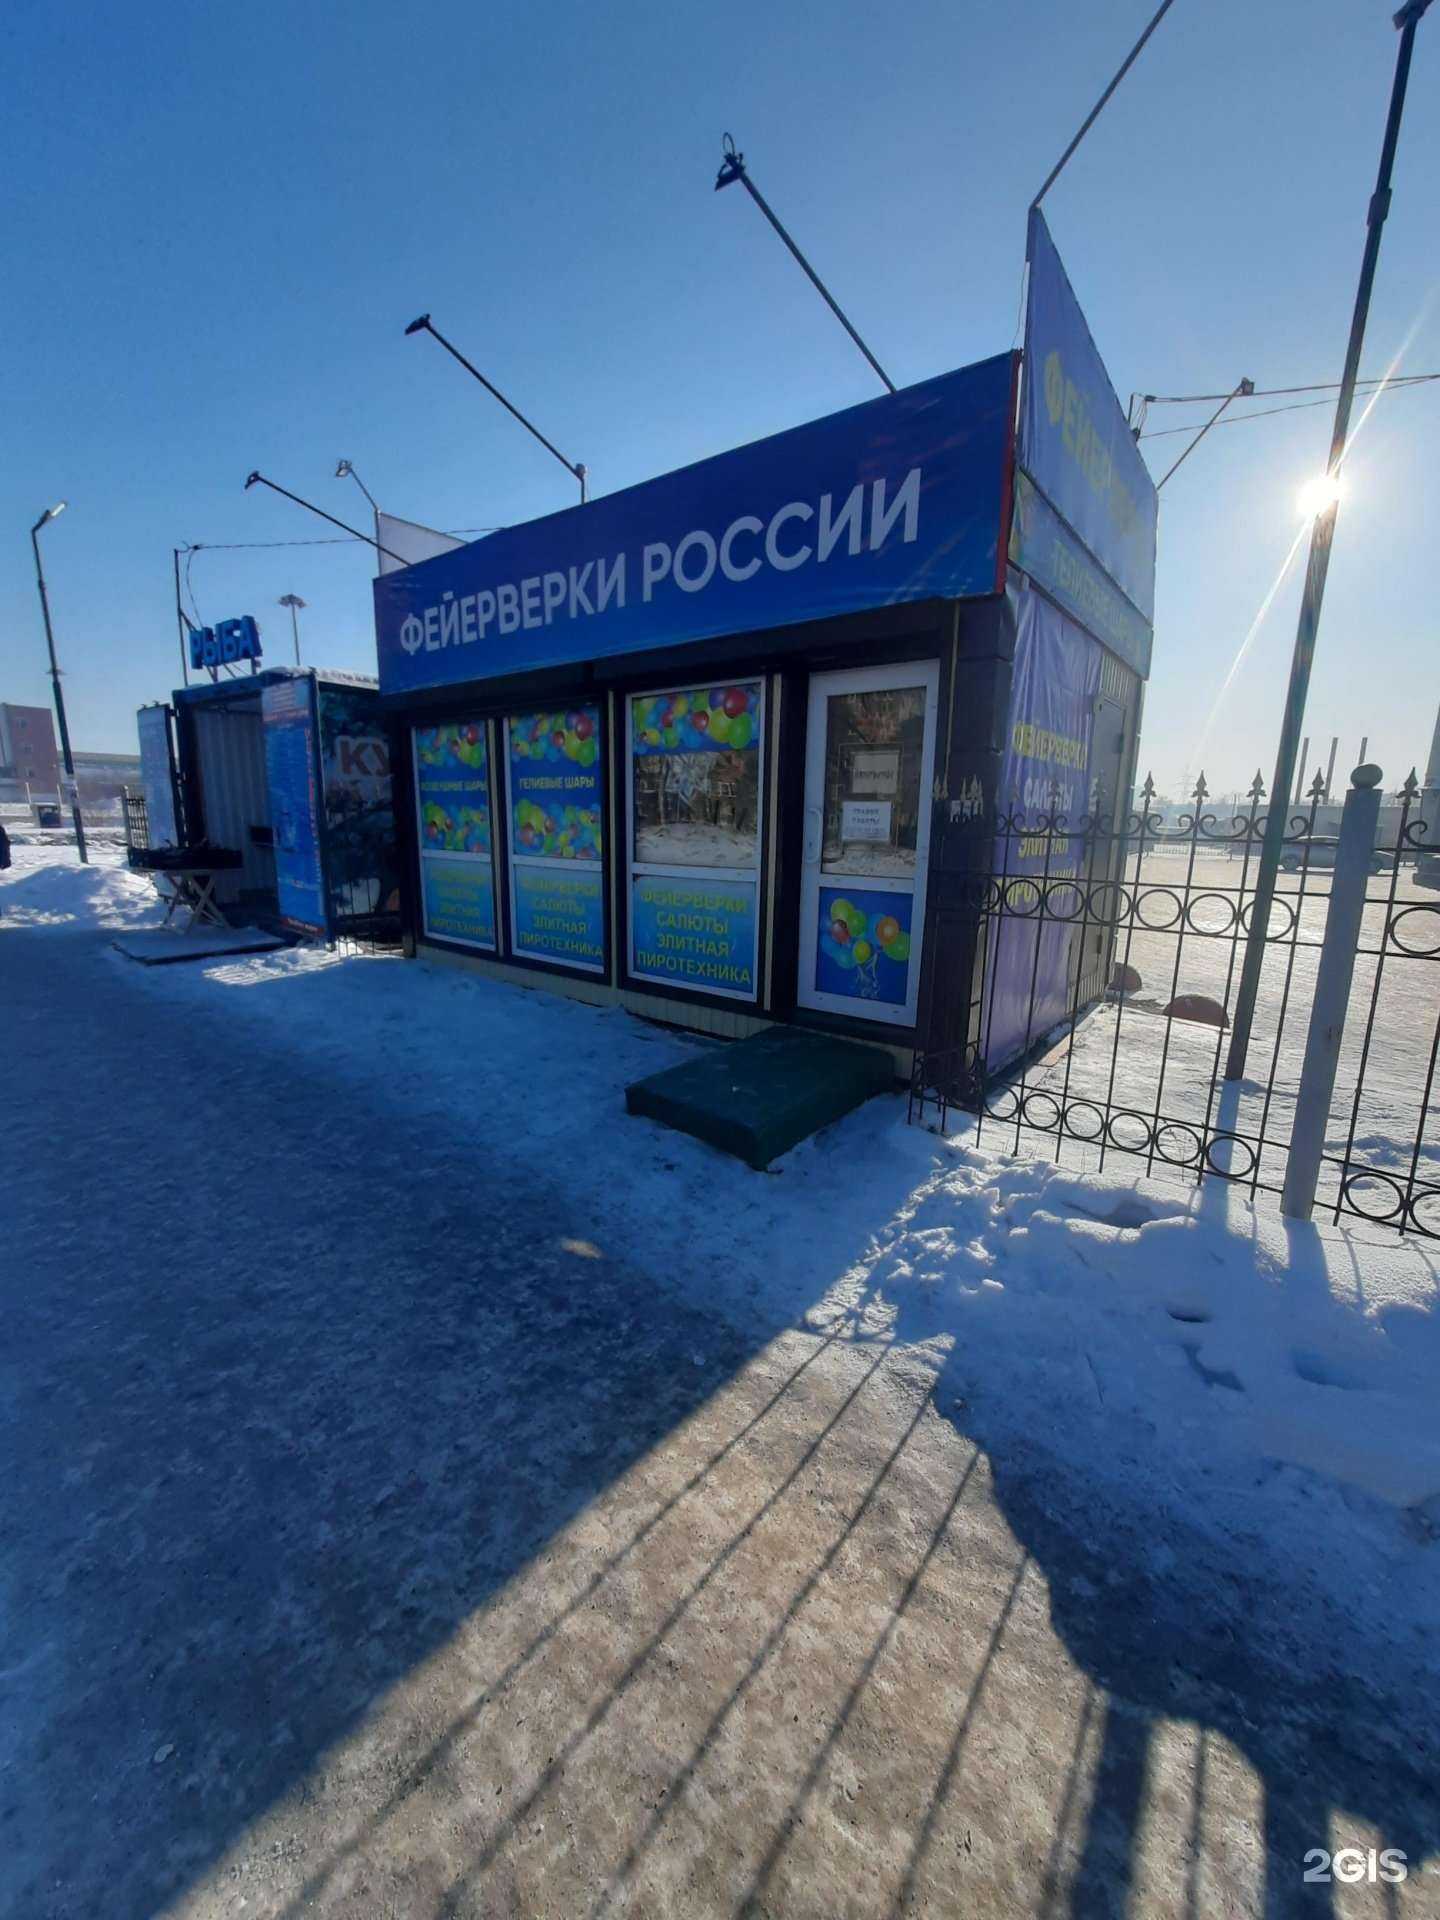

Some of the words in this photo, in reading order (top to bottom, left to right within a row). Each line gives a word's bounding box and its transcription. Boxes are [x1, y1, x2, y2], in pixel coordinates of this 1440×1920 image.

[399, 552, 626, 656] ФЕЙЕРВЕРКИ
[642, 468, 922, 603] РОССИИ
[190, 615, 262, 670] РЫБА
[1012, 721, 1088, 771] ФЕЙЕРВЕРКИ
[564, 775, 595, 788] ШАРЫ
[1023, 776, 1074, 811] САЛТЫ
[640, 886, 748, 913] ФЕЙЕРВЕРКИ
[533, 915, 587, 935] ЭЛИТНАЯ
[656, 911, 729, 935] САЛЮТЫ
[519, 931, 604, 957] ПИРОТЕХНИКА
[656, 933, 730, 957] ЭЛИТНАЯ
[638, 951, 751, 985] ПИРОТЕХНИКА
